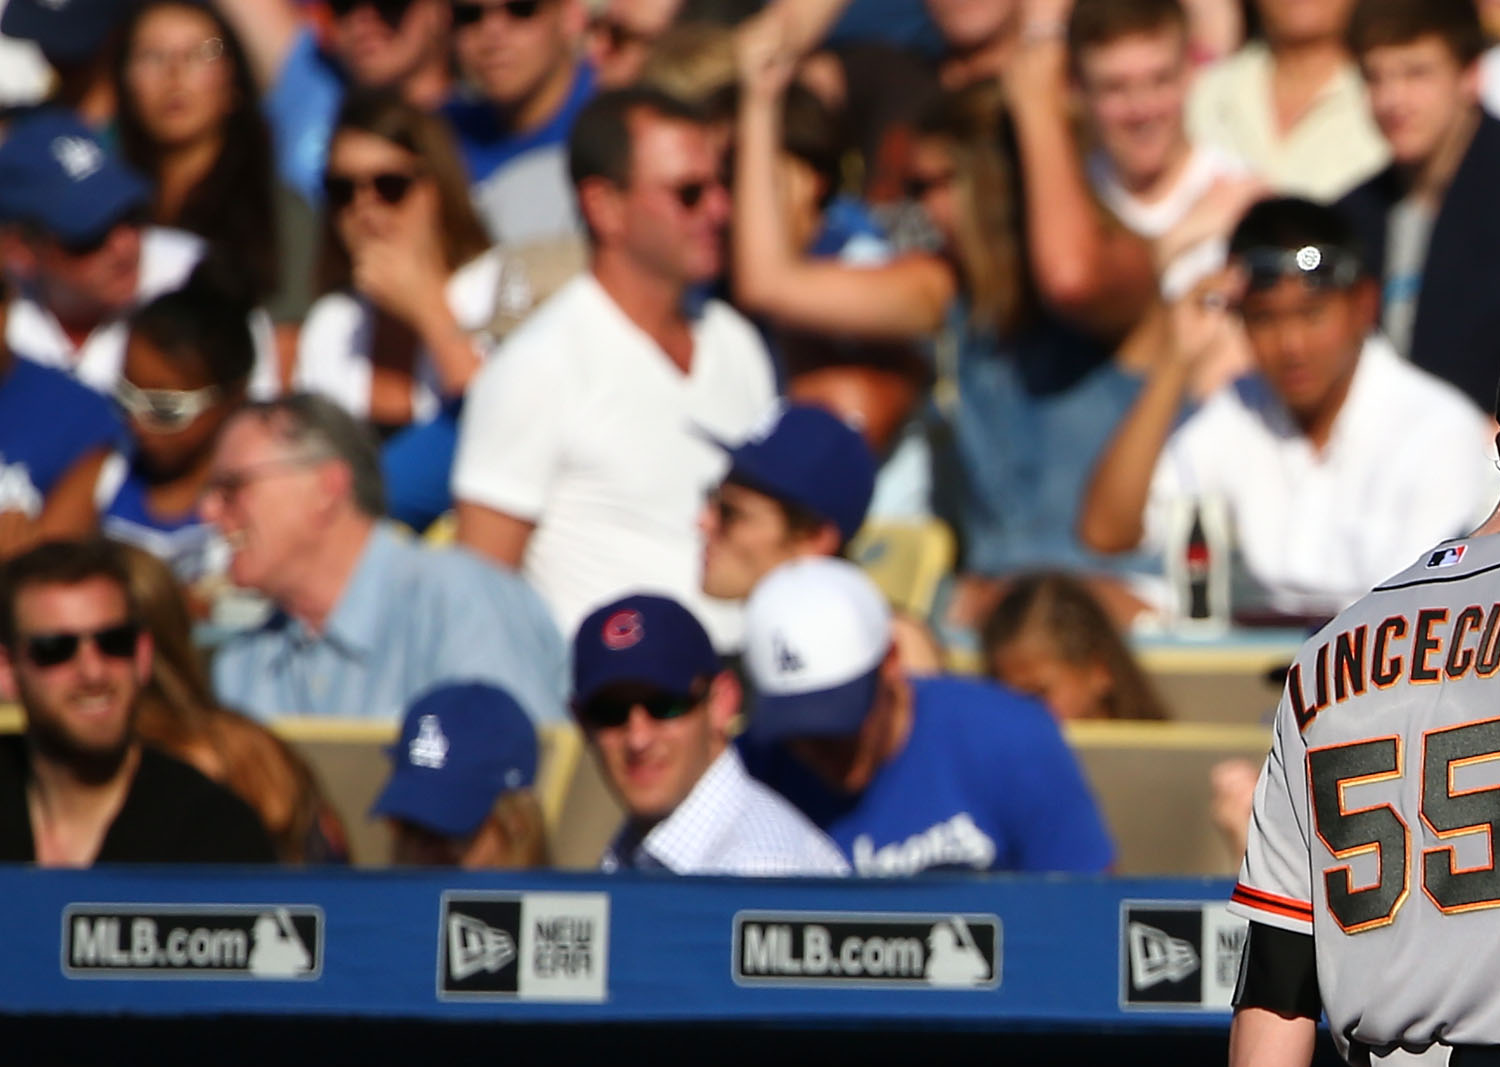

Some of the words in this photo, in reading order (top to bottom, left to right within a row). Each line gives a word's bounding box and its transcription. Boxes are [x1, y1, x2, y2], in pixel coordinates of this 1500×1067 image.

[73, 916, 248, 967] MLB.com
[535, 917, 593, 942] NEW
[744, 924, 925, 976] MLB.com
[535, 943, 593, 979] ERA
